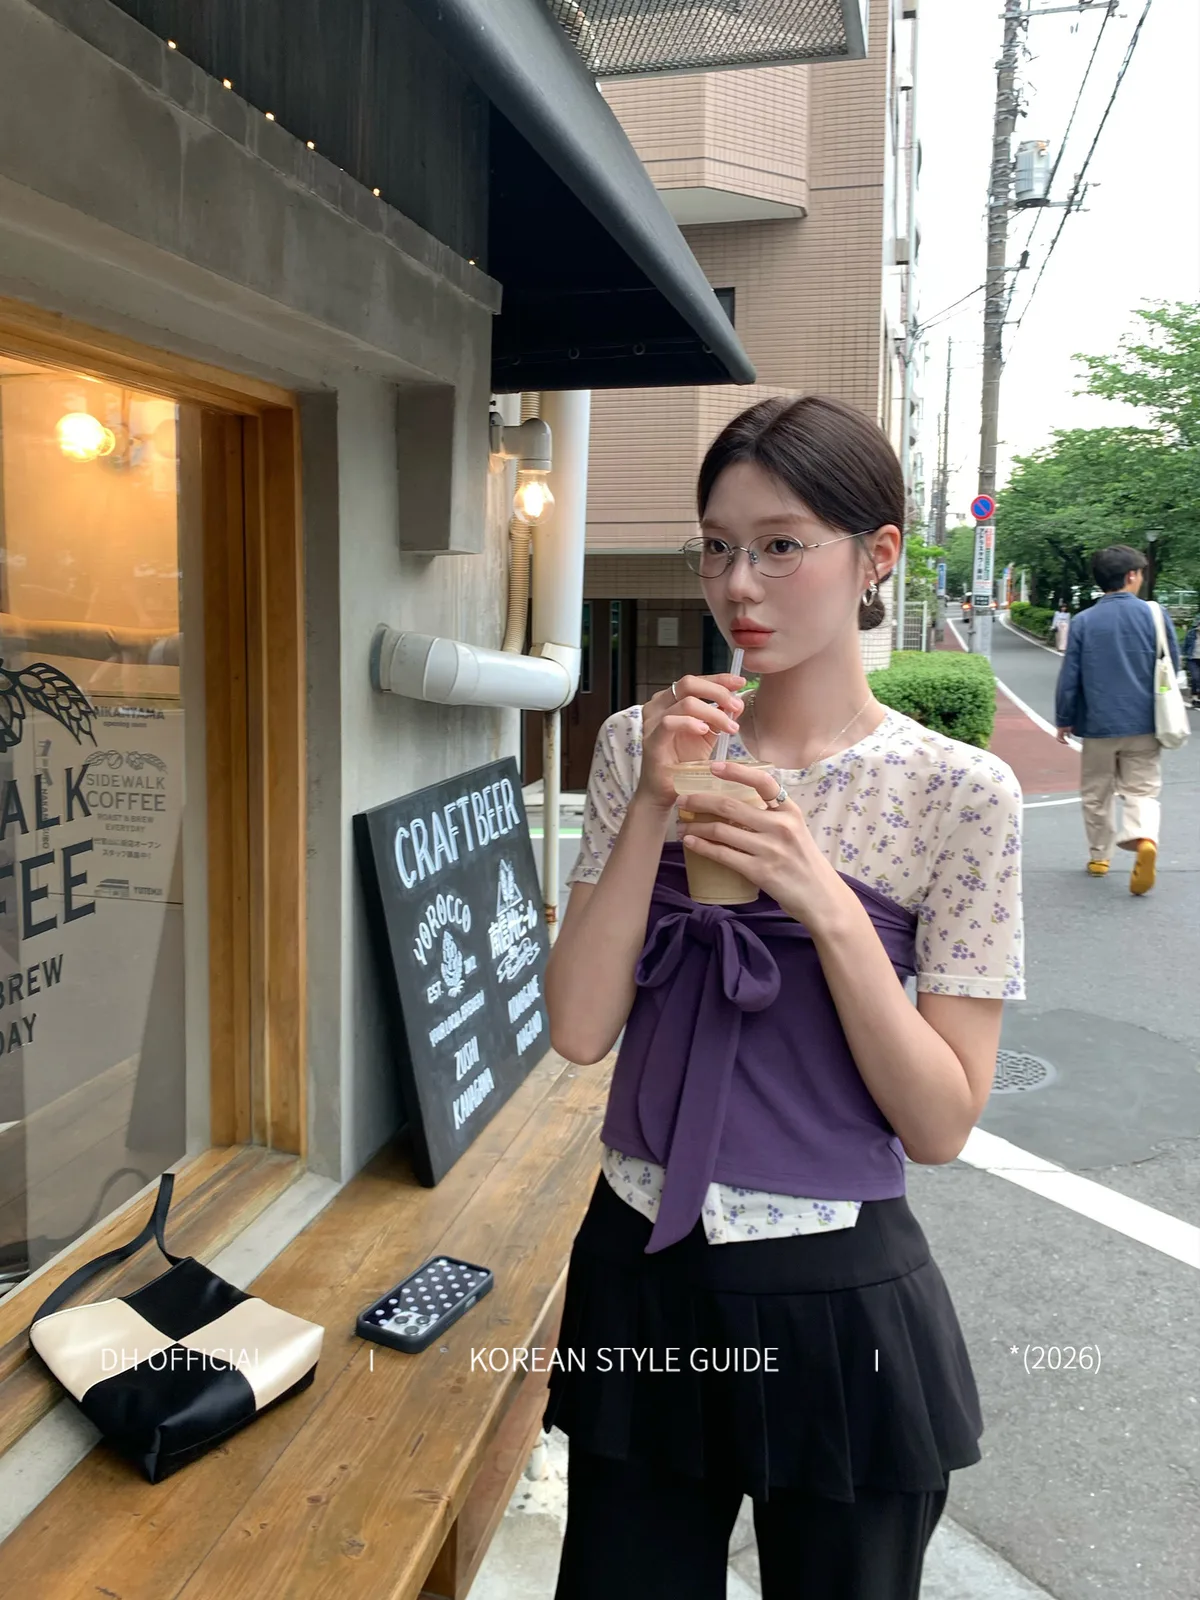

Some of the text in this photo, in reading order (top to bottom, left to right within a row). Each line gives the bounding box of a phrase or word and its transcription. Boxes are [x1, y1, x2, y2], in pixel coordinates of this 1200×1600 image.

[86, 773, 165, 789] SIDEWALK
[86, 790, 166, 812] COFFEE
[105, 823, 146, 833] EVERYDAY
[413, 893, 472, 965] YOROCCO
[454, 1036, 480, 1081] ZUSHI
